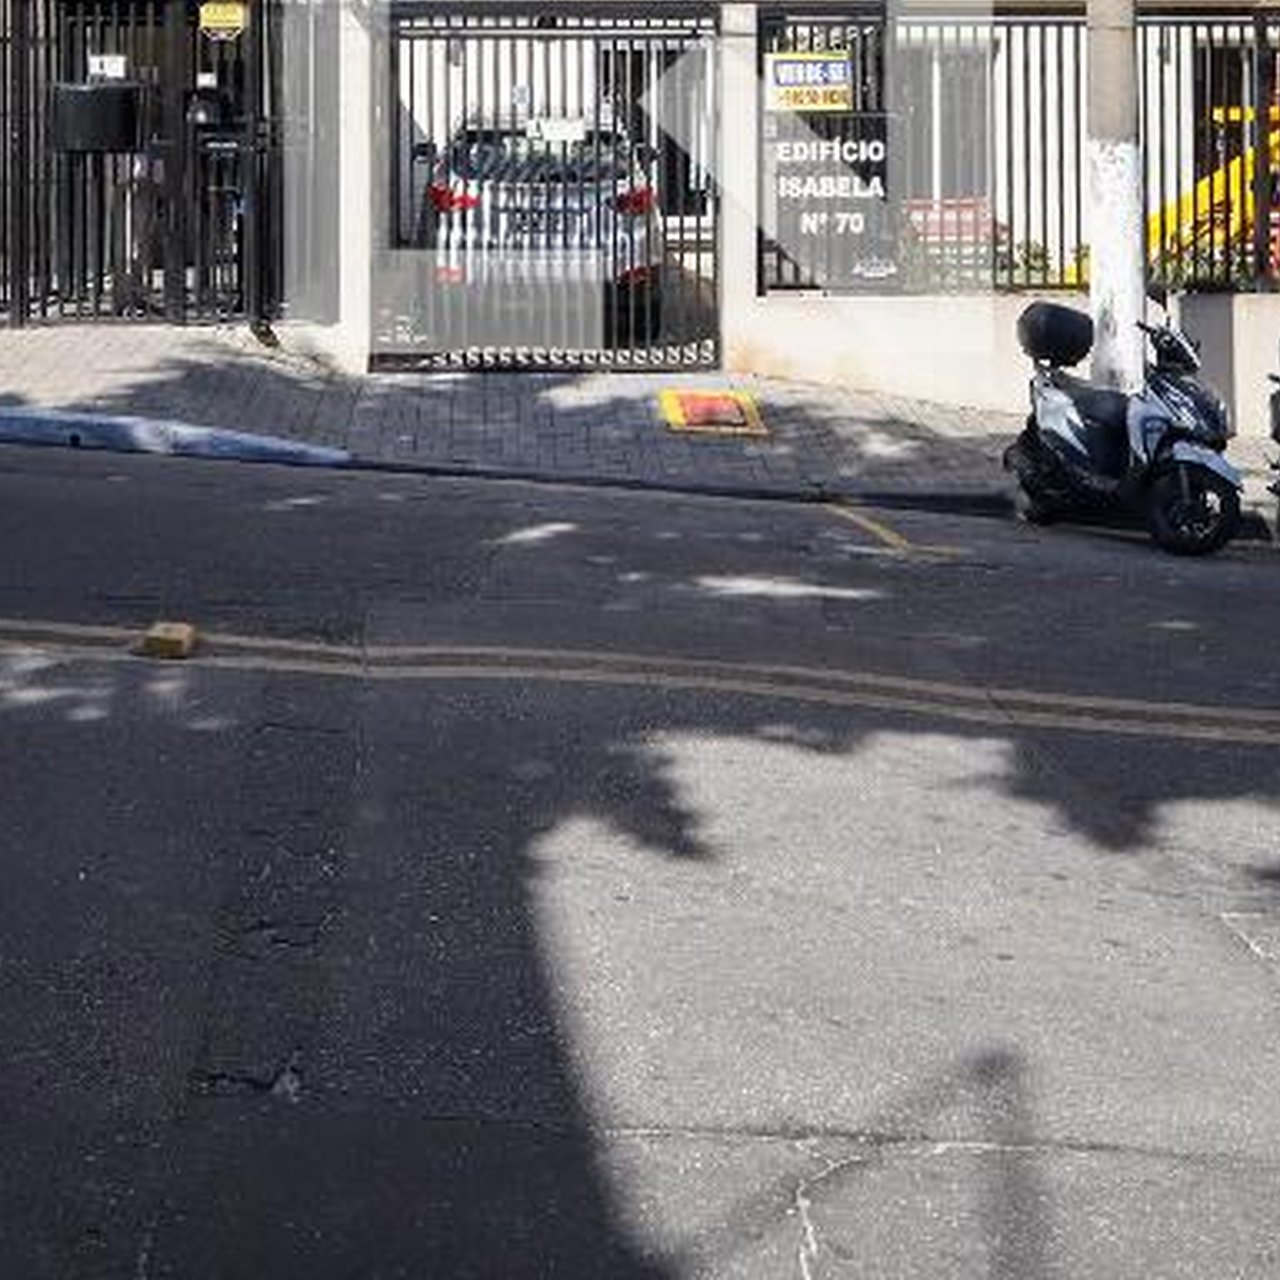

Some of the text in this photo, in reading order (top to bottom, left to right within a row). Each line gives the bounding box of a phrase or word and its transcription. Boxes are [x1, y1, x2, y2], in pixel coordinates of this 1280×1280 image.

[776, 136, 885, 161] EDIFÍCIO
[779, 175, 885, 198] ISABELA
[835, 212, 864, 235] 70
